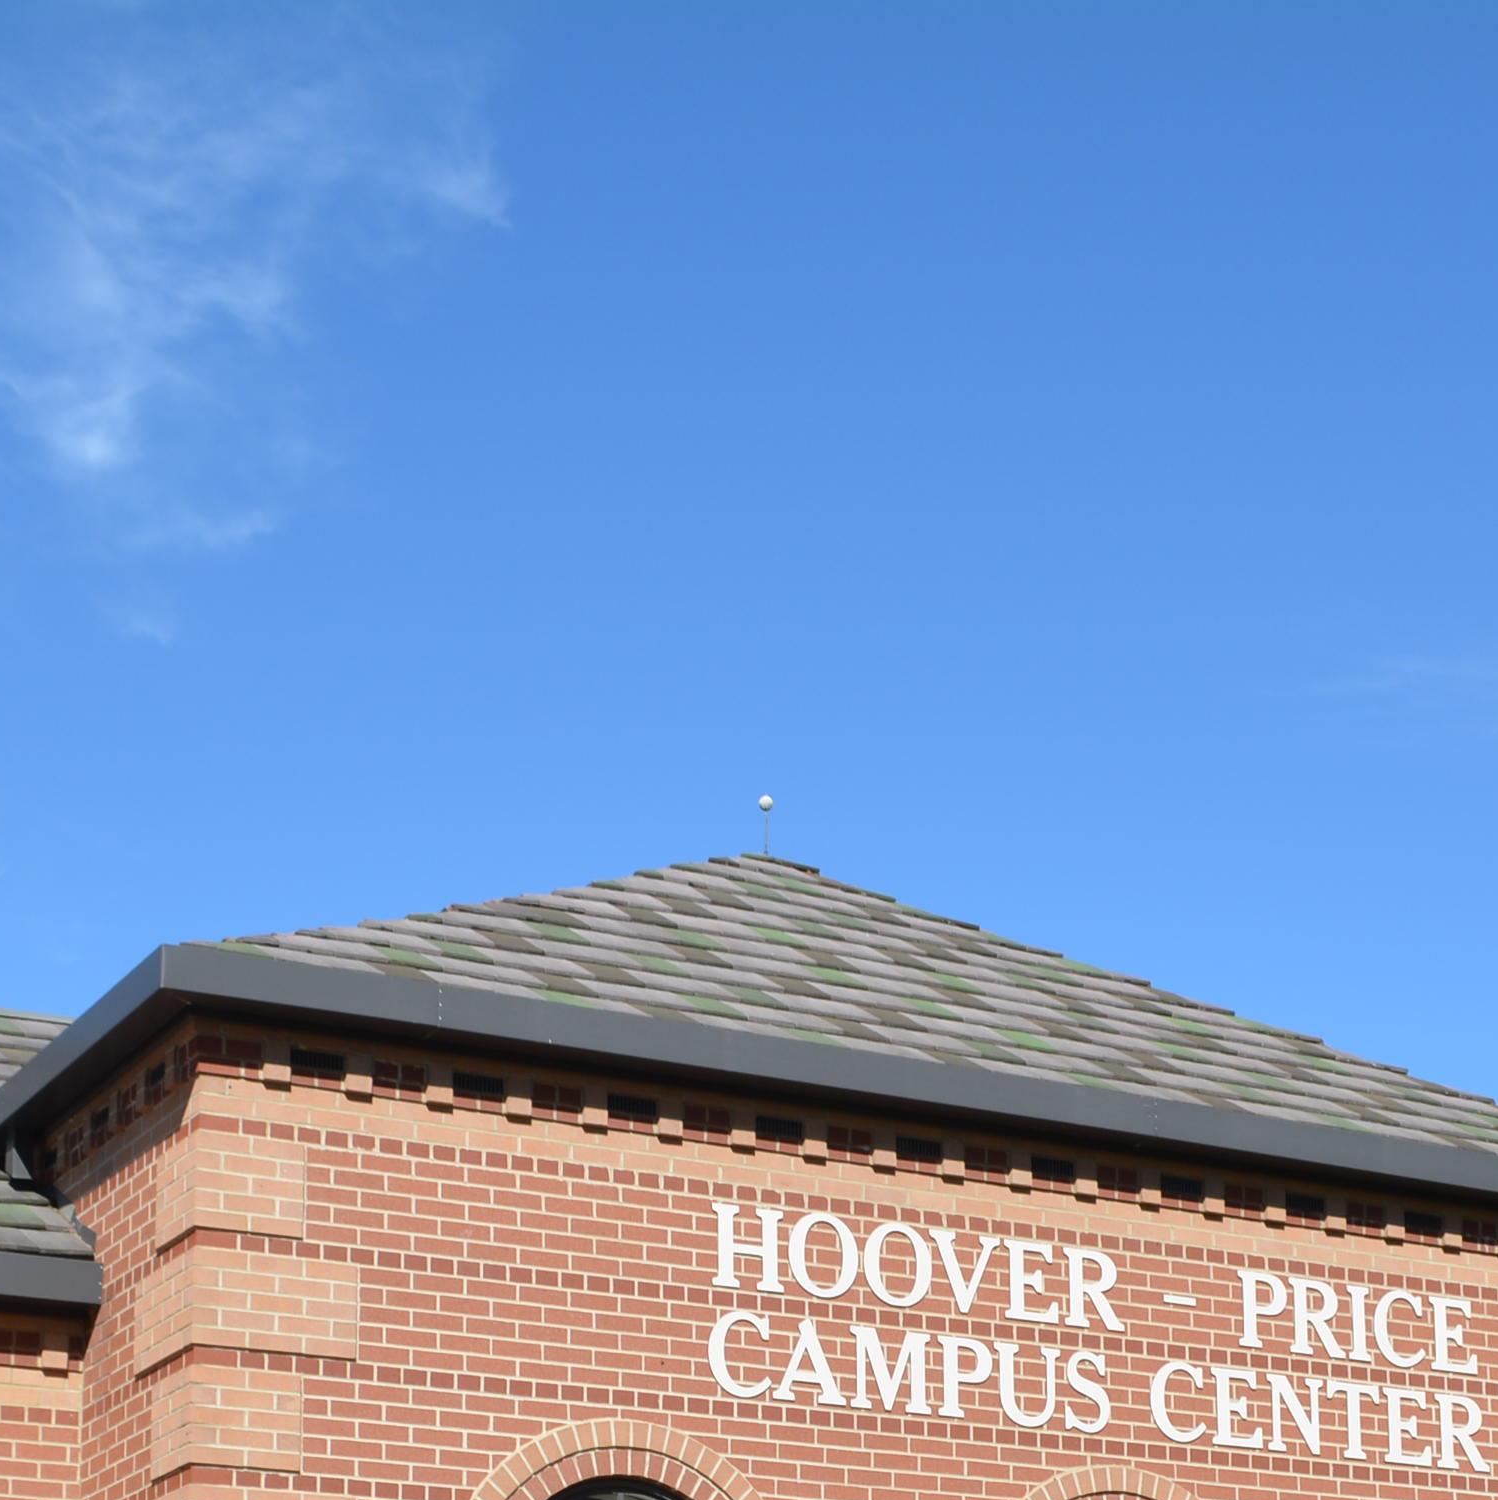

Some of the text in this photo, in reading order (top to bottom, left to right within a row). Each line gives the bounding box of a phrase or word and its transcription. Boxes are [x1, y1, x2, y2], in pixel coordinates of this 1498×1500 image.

[711, 1202, 1479, 1375] HOOVER - PRICE
[707, 1310, 1495, 1473] CAMPUS CENTER
